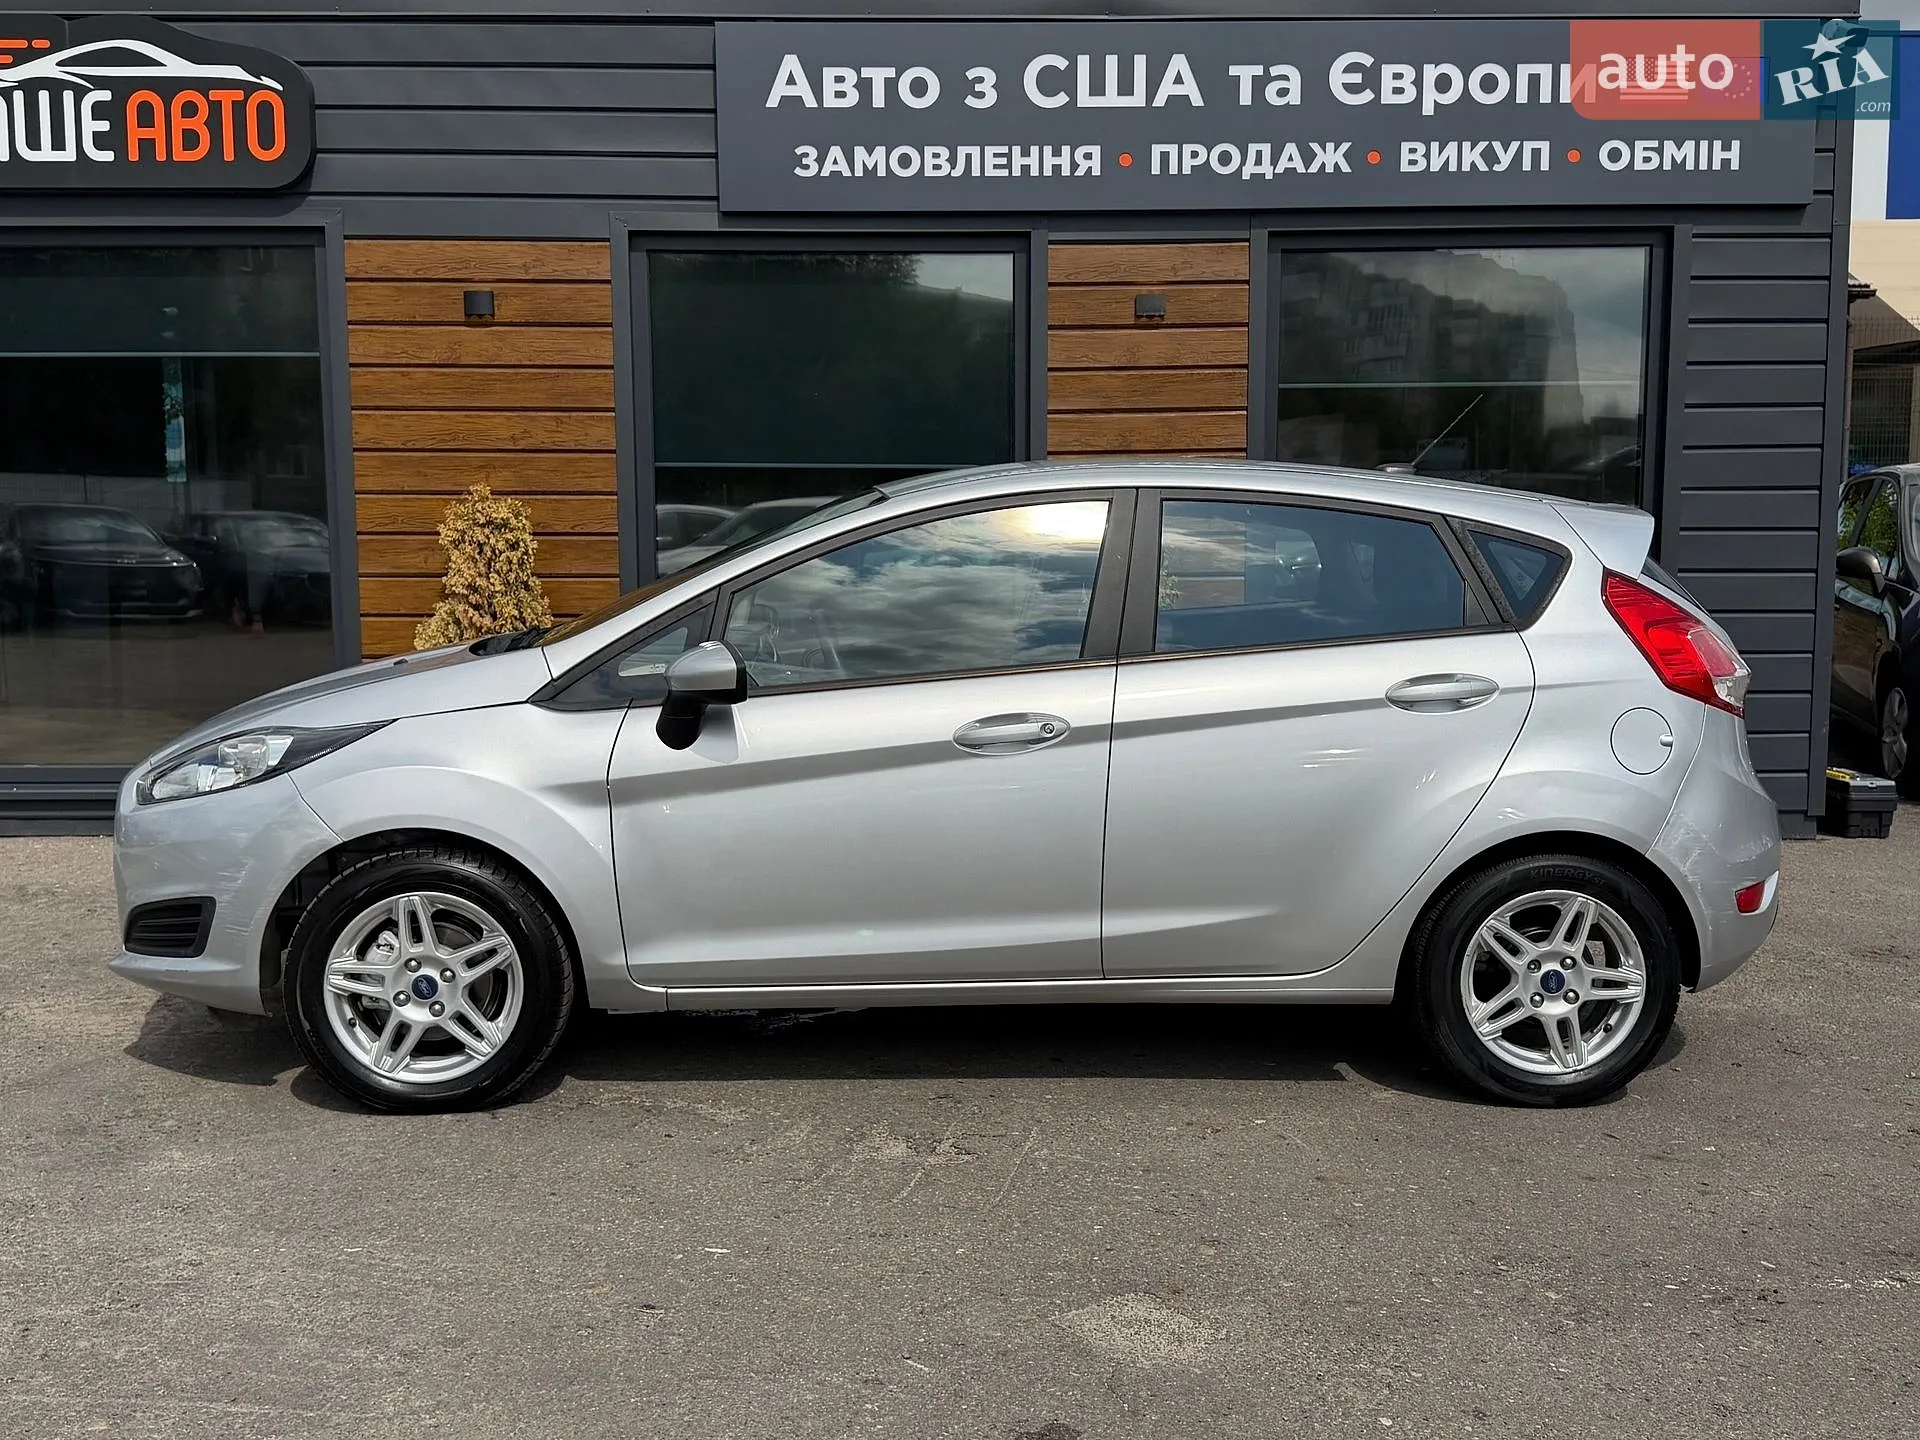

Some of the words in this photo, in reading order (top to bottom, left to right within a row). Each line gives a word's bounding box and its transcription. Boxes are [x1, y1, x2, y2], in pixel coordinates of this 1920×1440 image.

[766, 54, 941, 109] Авто
[964, 66, 998, 109] з
[1023, 53, 1205, 109] США
[1228, 64, 1302, 106] та
[126, 89, 287, 162] АВТО
[793, 144, 1102, 178] ЗАМОВЛЕННЯ
[1151, 142, 1352, 180] ПРОДАЖ
[1399, 140, 1550, 173] ВИКУП
[1598, 139, 1741, 172] ОБМІН
